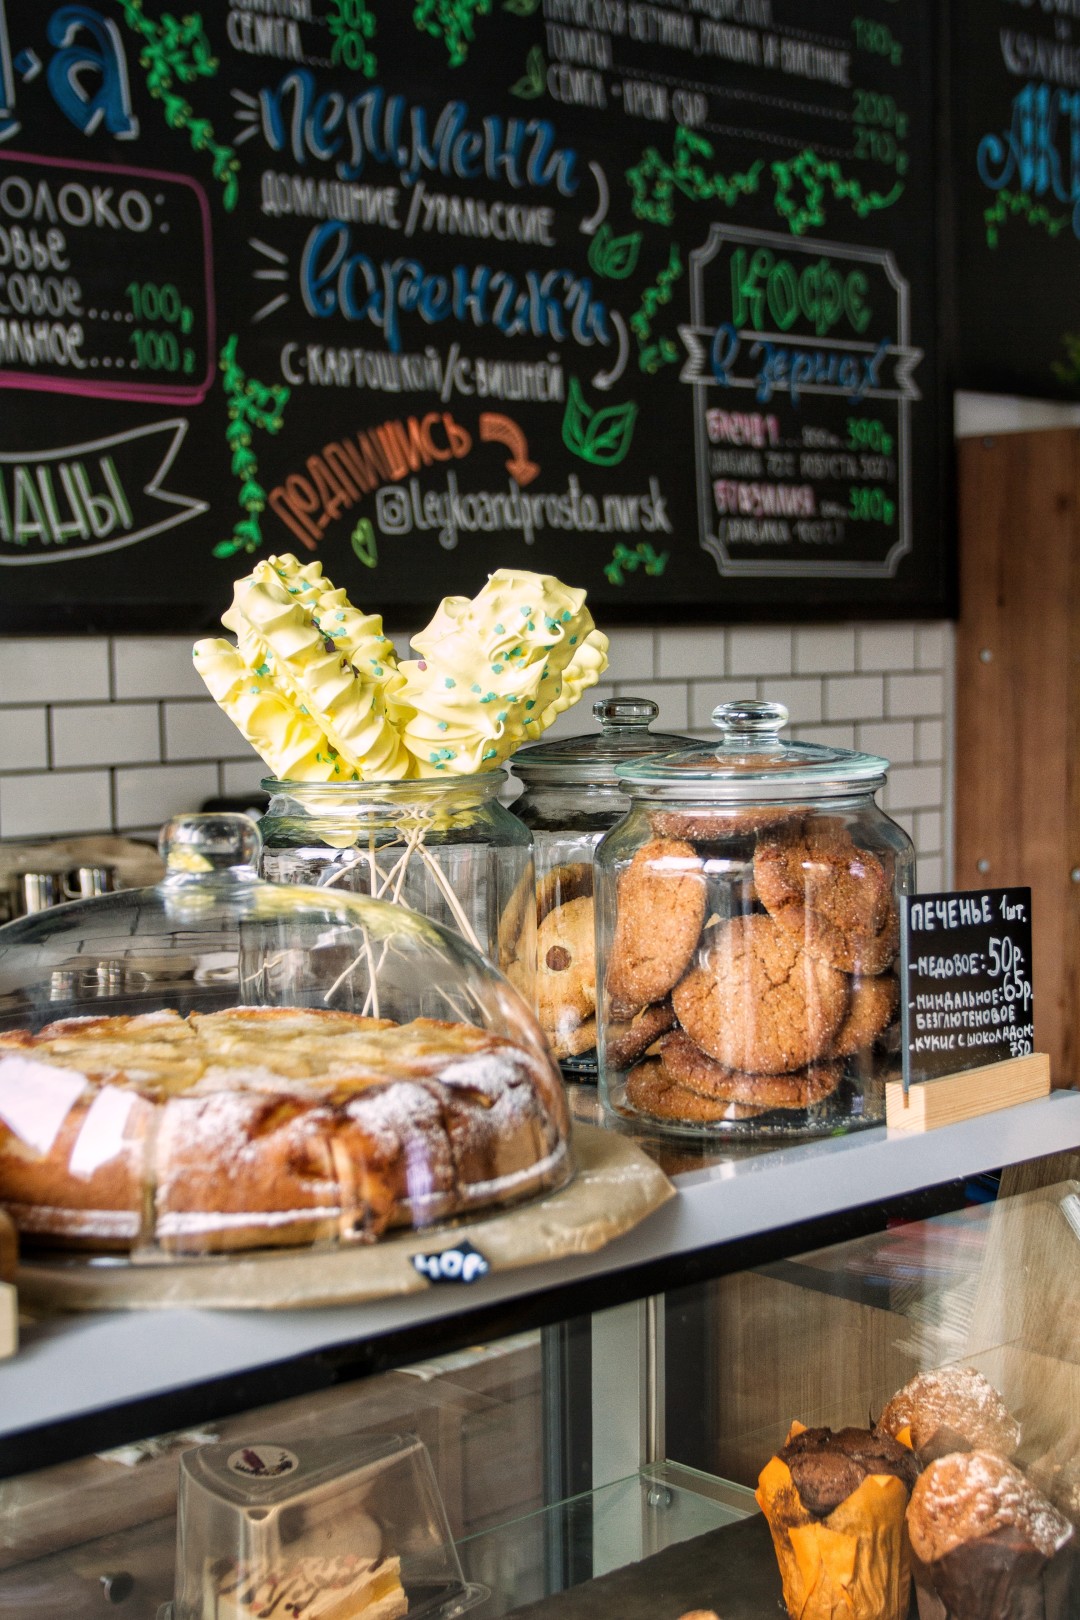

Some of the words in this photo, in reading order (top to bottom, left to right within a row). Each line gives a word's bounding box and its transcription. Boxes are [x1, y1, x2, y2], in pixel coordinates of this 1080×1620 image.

[730, 245, 873, 337] КОФЕ
[268, 411, 473, 551] ПОДПИШИСЬ
[911, 895, 992, 931] ПЕЧЕНЬЕ
[915, 1004, 1016, 1030] БЕЗГЛЮТЕНОВОЕ
